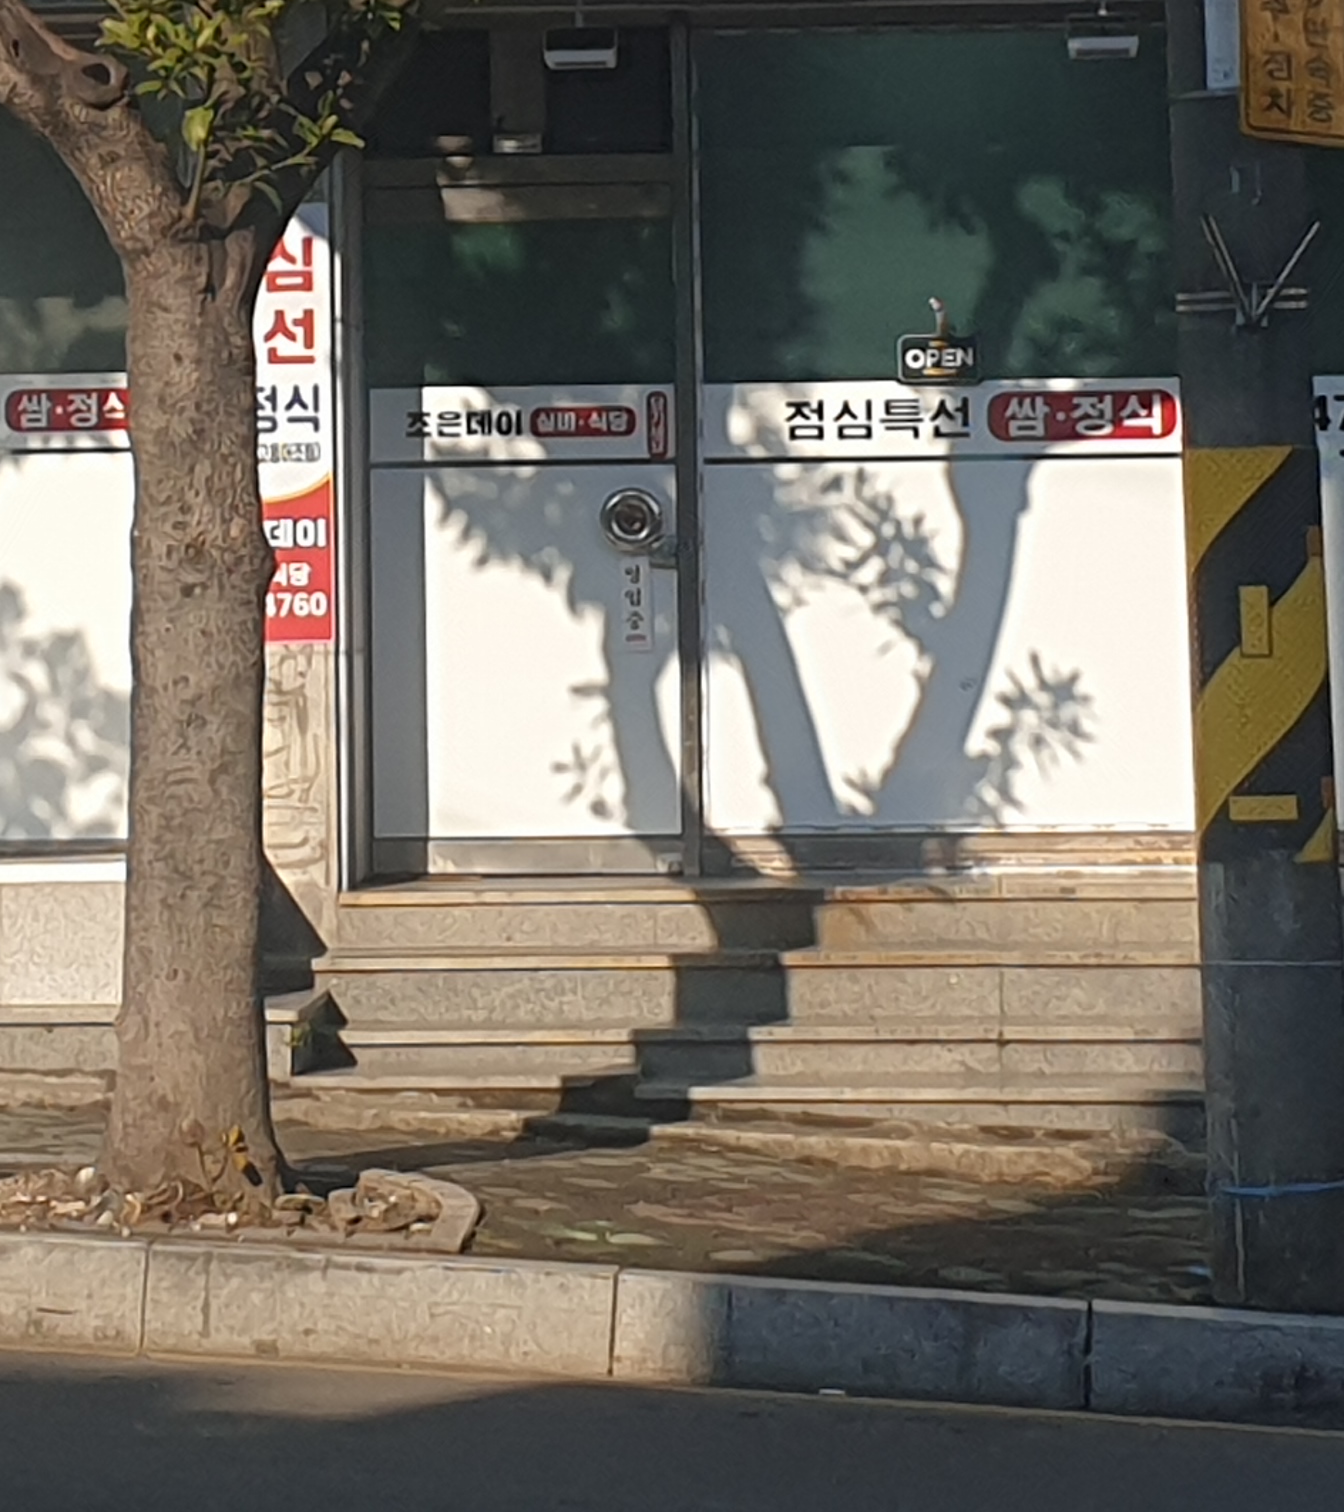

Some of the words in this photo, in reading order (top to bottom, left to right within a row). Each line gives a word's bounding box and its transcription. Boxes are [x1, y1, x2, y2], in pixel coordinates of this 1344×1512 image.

[904, 345, 975, 370] OPEN
[405, 408, 524, 439] 조은데이
[783, 396, 974, 441] 점심특선
